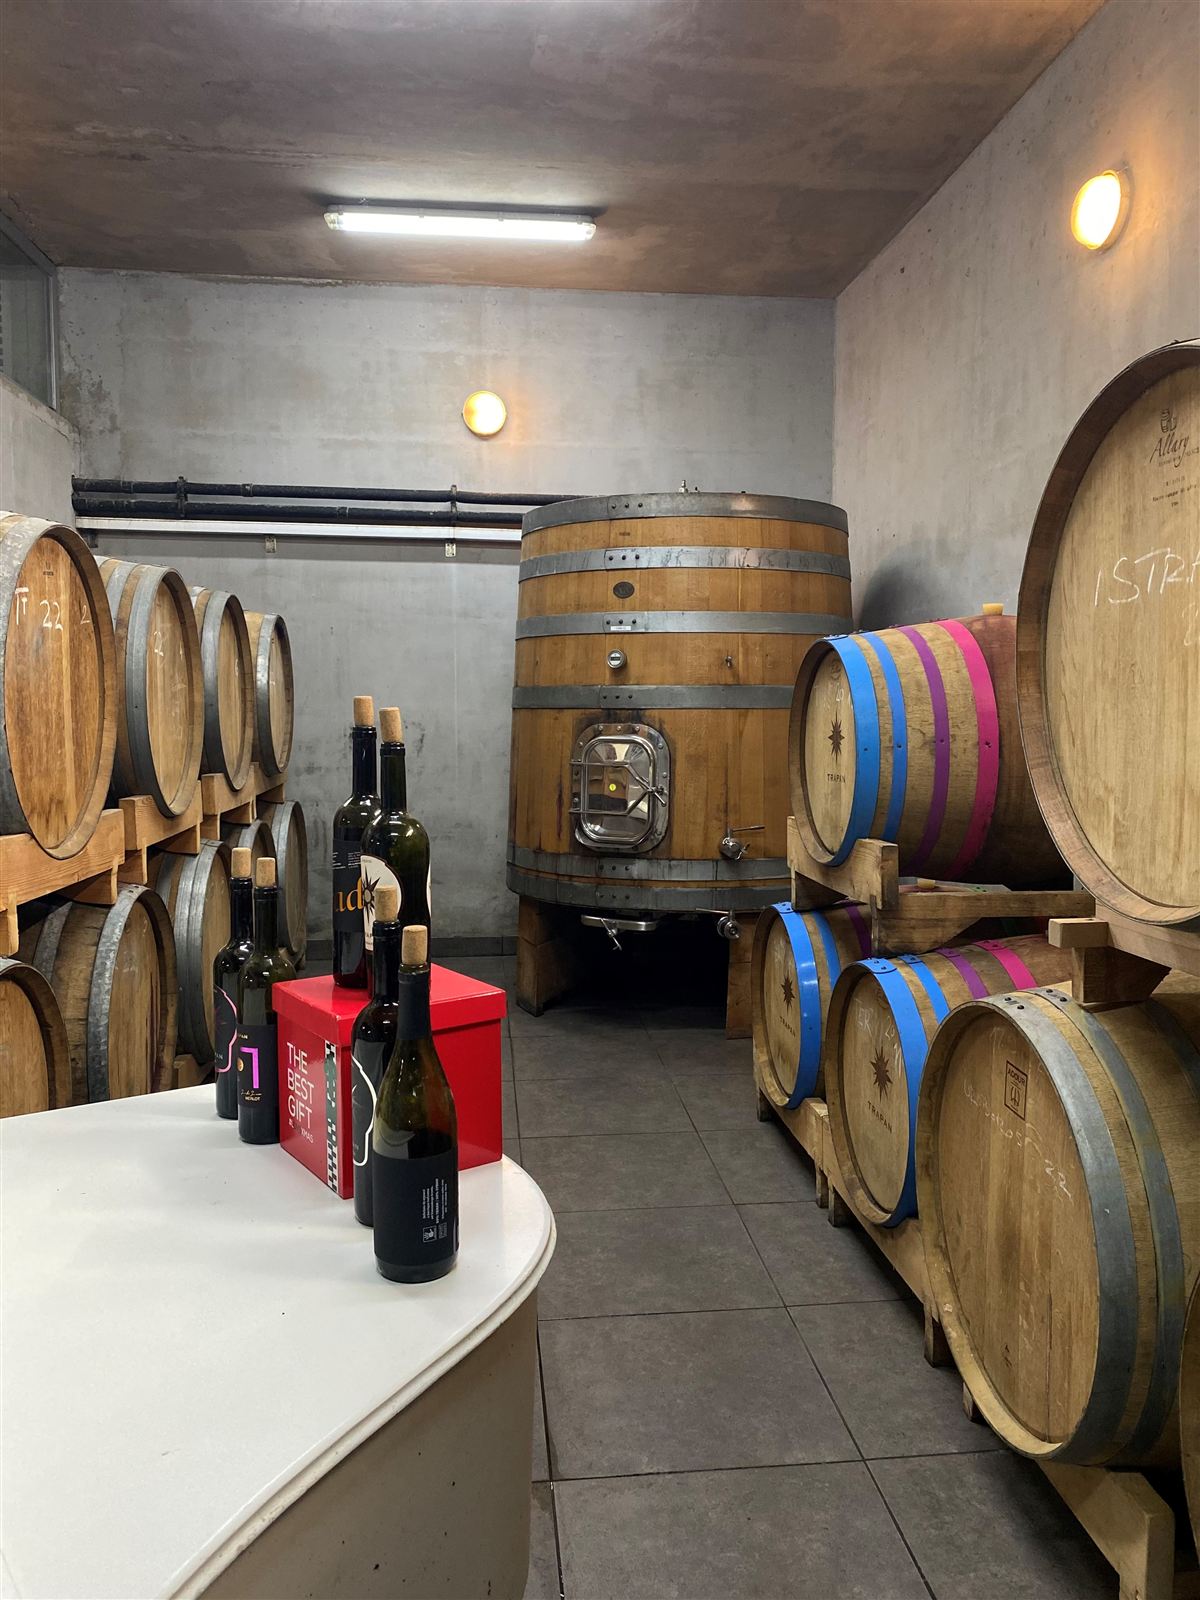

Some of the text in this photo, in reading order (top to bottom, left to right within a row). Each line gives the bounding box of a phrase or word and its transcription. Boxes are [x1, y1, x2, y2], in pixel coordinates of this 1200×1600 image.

[39, 599, 64, 631] 22
[827, 772, 846, 784] TRAPAN
[286, 1042, 308, 1075] THE
[287, 1068, 315, 1105] BEST
[287, 1096, 313, 1130] GIFT
[867, 1100, 893, 1135] TRAPAN
